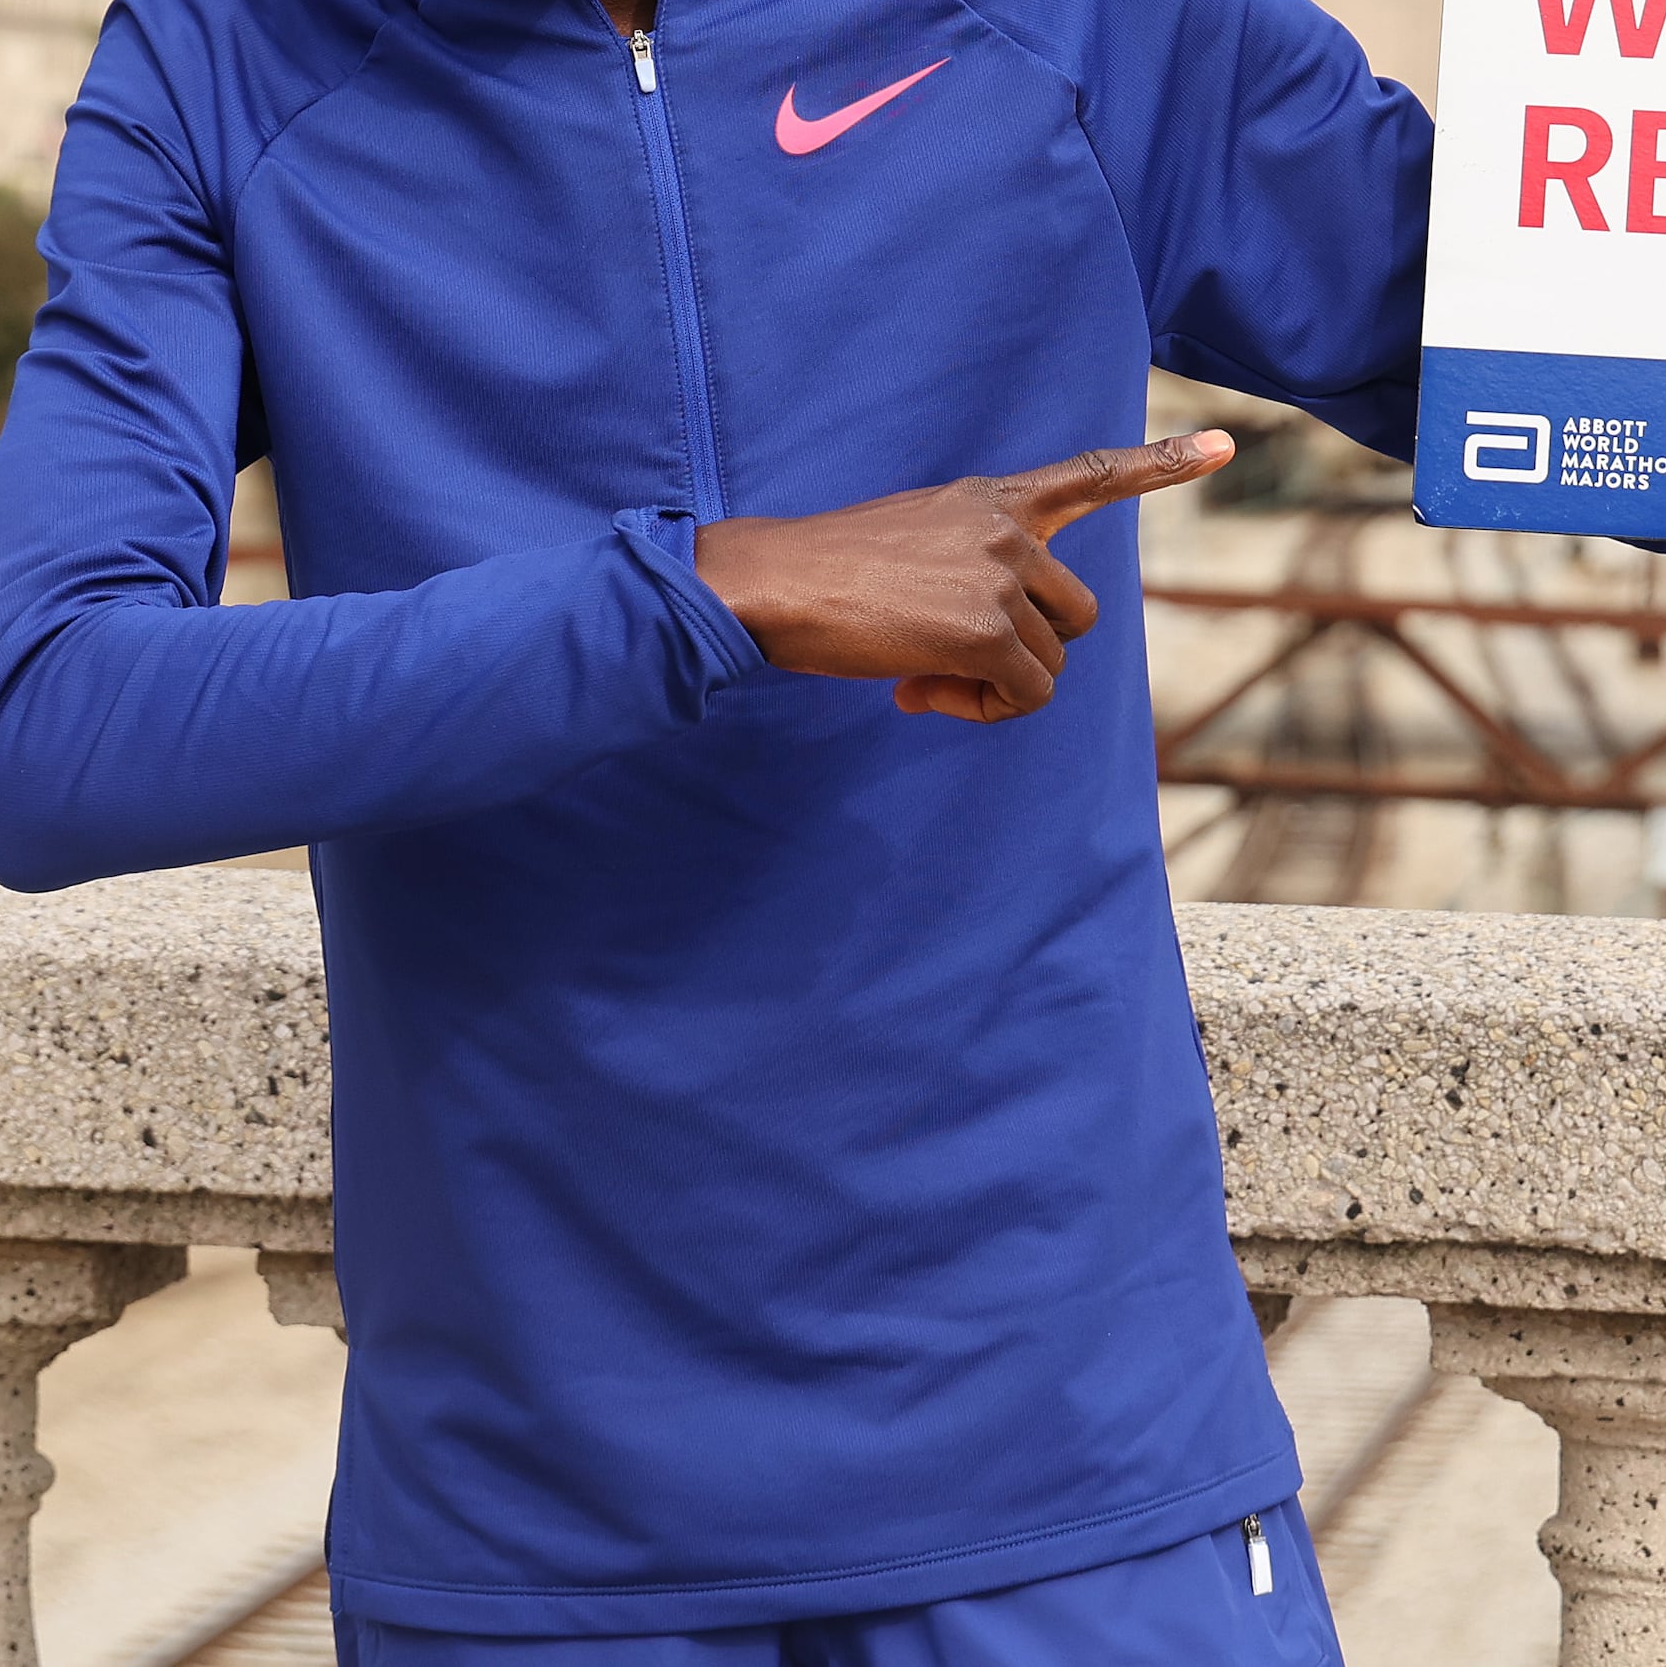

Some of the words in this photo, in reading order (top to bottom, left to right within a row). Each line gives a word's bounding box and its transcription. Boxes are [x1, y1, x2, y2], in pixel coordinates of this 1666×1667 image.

[1562, 417, 1648, 438] ABBOTT
[1562, 433, 1639, 454] WORLD
[1560, 469, 1650, 491] MAJORS
